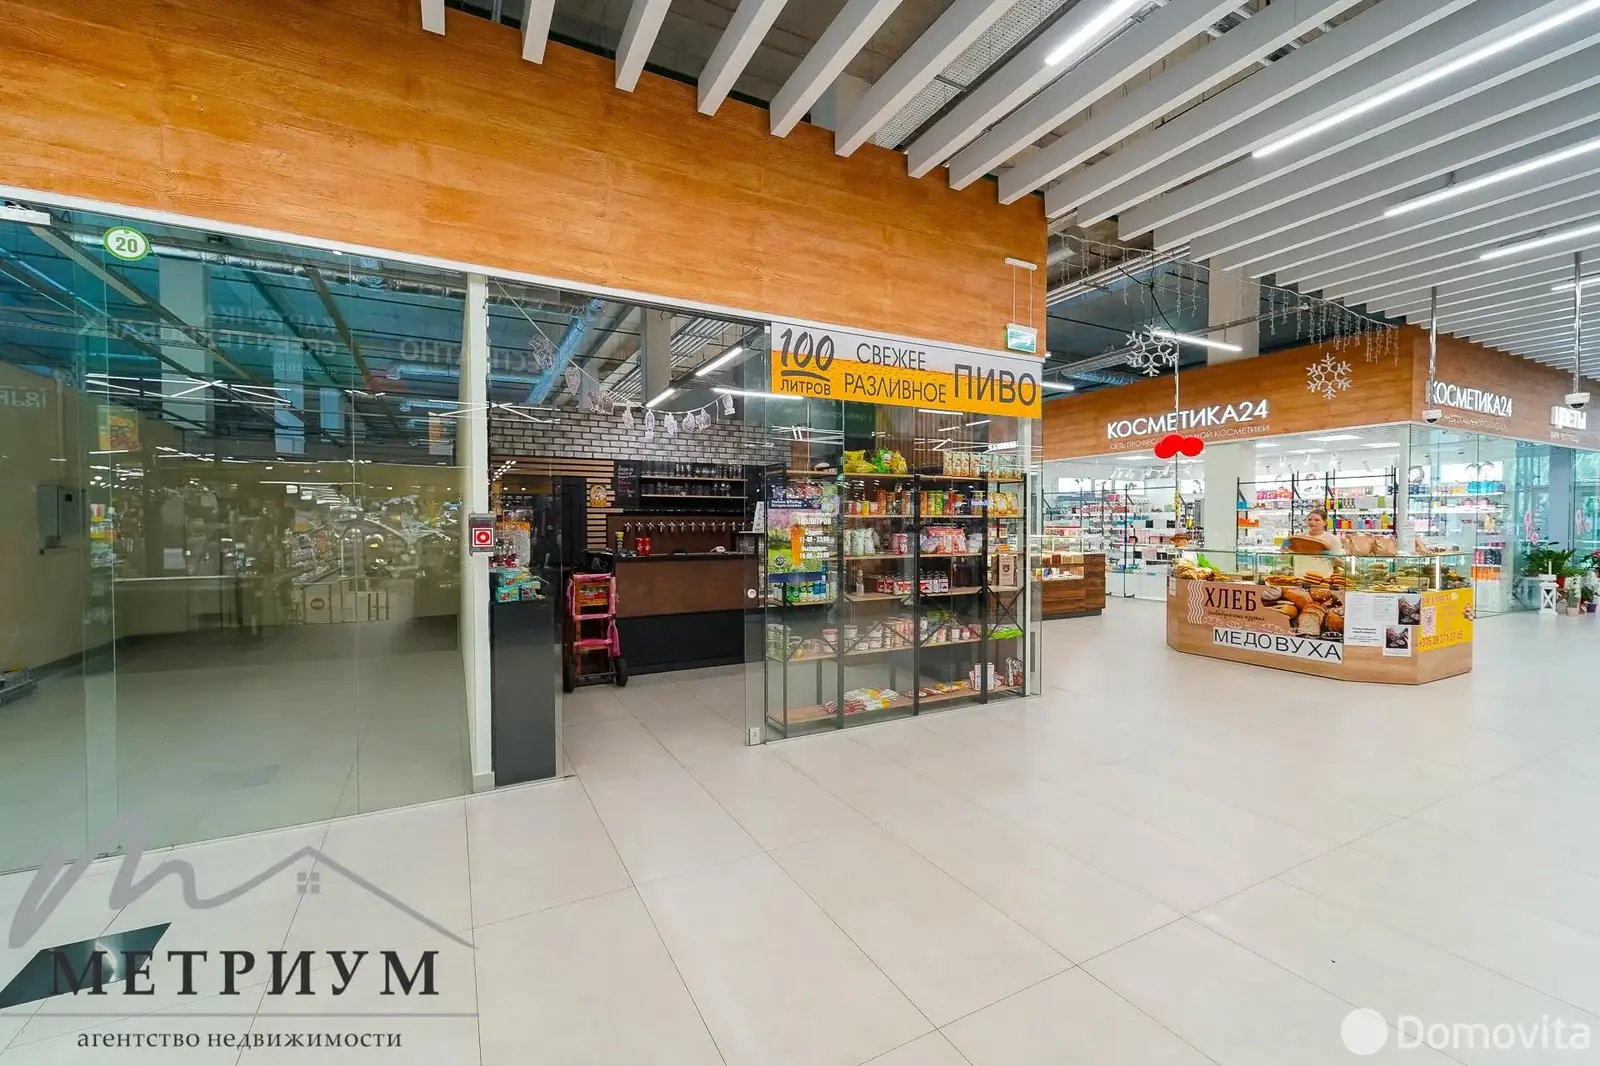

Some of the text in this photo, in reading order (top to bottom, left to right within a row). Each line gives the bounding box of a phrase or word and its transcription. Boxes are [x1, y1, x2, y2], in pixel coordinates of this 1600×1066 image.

[115, 237, 138, 254] 20
[780, 328, 835, 371] 100
[856, 343, 926, 371] СВЕЖЕЕ
[780, 378, 831, 396] ЛИТРОВ
[844, 373, 946, 404] РАЗЛИВНОЕ
[954, 363, 1037, 407] ПИВО
[1107, 398, 1269, 440] КОСМЕТИКА24
[1214, 424, 1270, 438] КОСМЕТИКИ
[1204, 587, 1257, 612] ХЛЕБ
[1214, 628, 1342, 662] МЕДОВУХА
